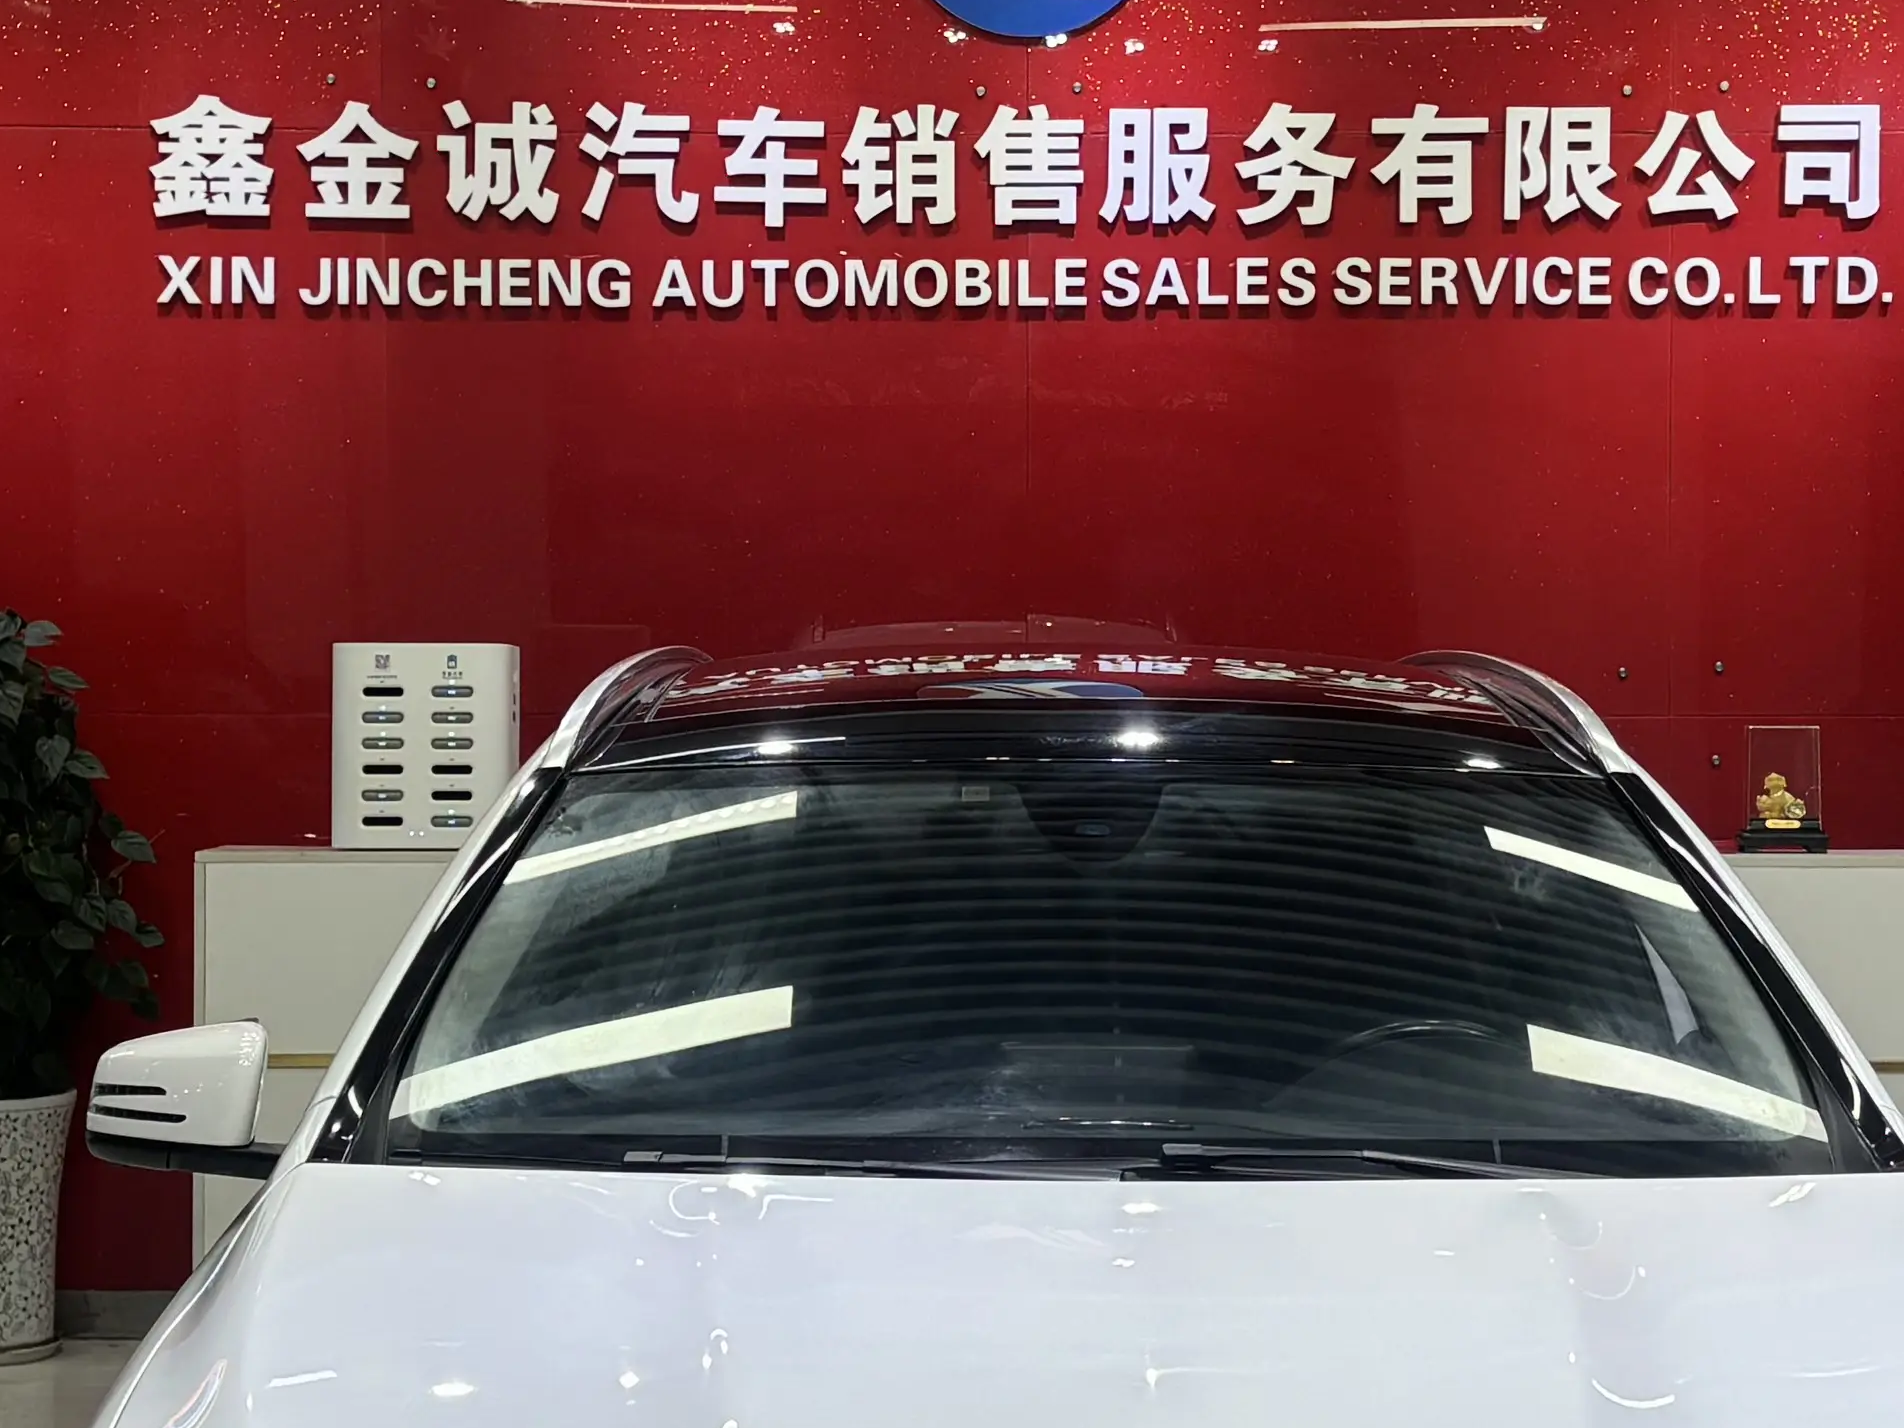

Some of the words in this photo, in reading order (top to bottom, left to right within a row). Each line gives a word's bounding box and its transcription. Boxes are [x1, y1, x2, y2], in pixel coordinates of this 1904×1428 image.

[149, 94, 1882, 228] 鑫金诚汽车销售服务有限公司
[156, 256, 275, 306] XIN
[298, 256, 632, 309] JINCHENG
[652, 257, 1088, 309] AUTOMOBILE
[1101, 257, 1318, 307] SALES
[1333, 257, 1611, 307] SERVICE
